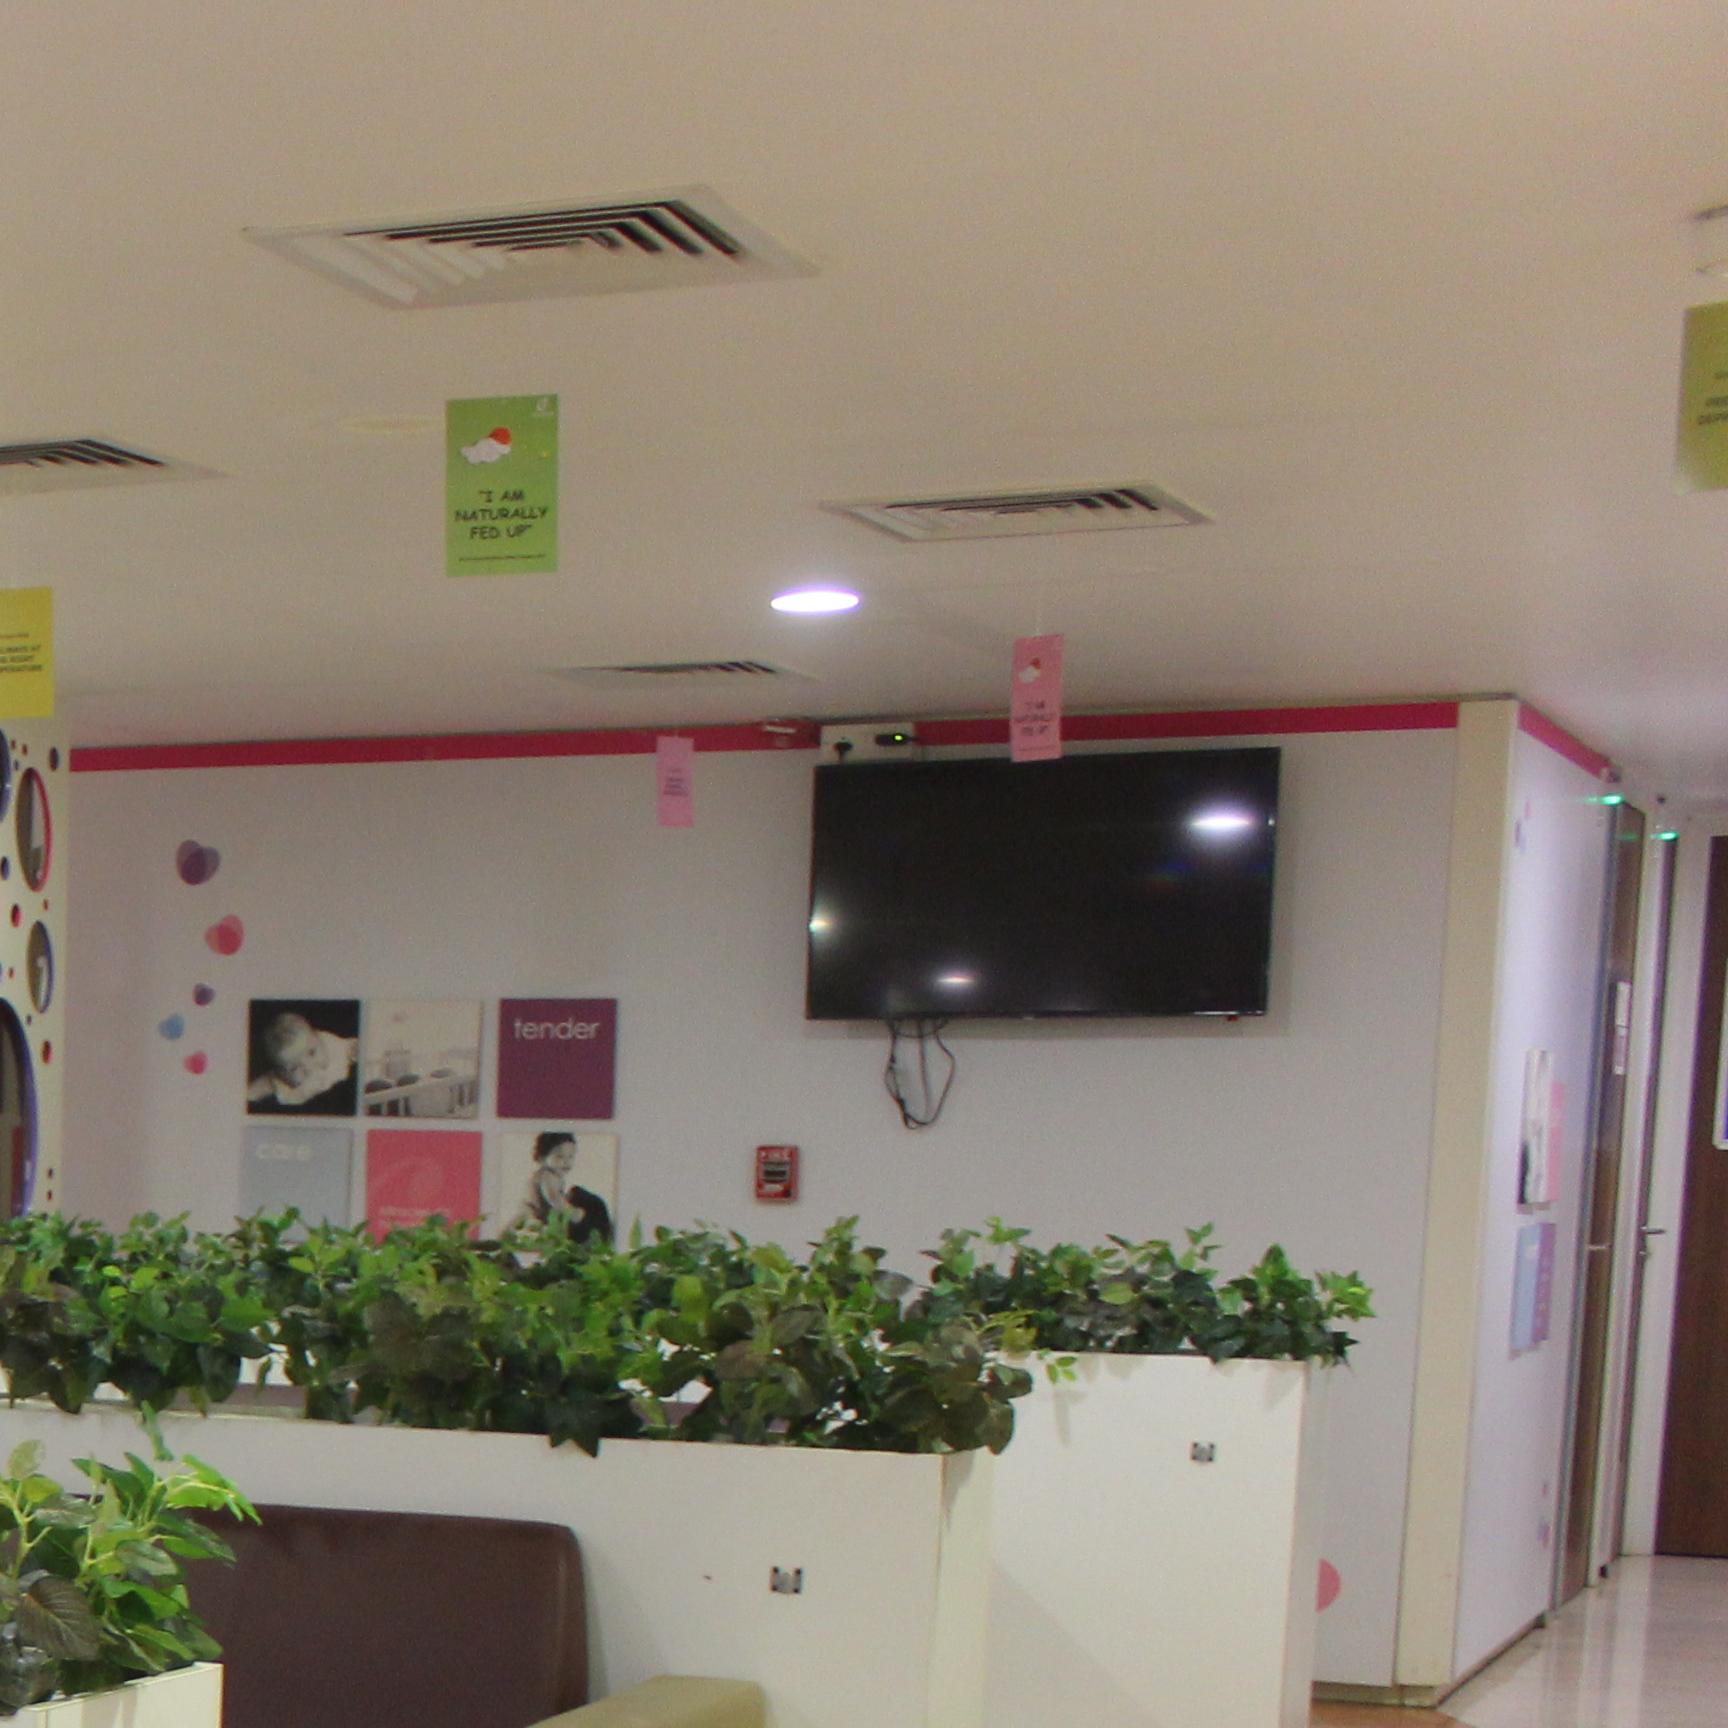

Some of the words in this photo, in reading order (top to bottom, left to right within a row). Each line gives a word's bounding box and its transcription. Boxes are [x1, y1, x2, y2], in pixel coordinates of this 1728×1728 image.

[501, 489, 524, 502] AM
[455, 506, 548, 522] NATURALLY
[470, 526, 500, 540] FED
[514, 1018, 600, 1040] tender
